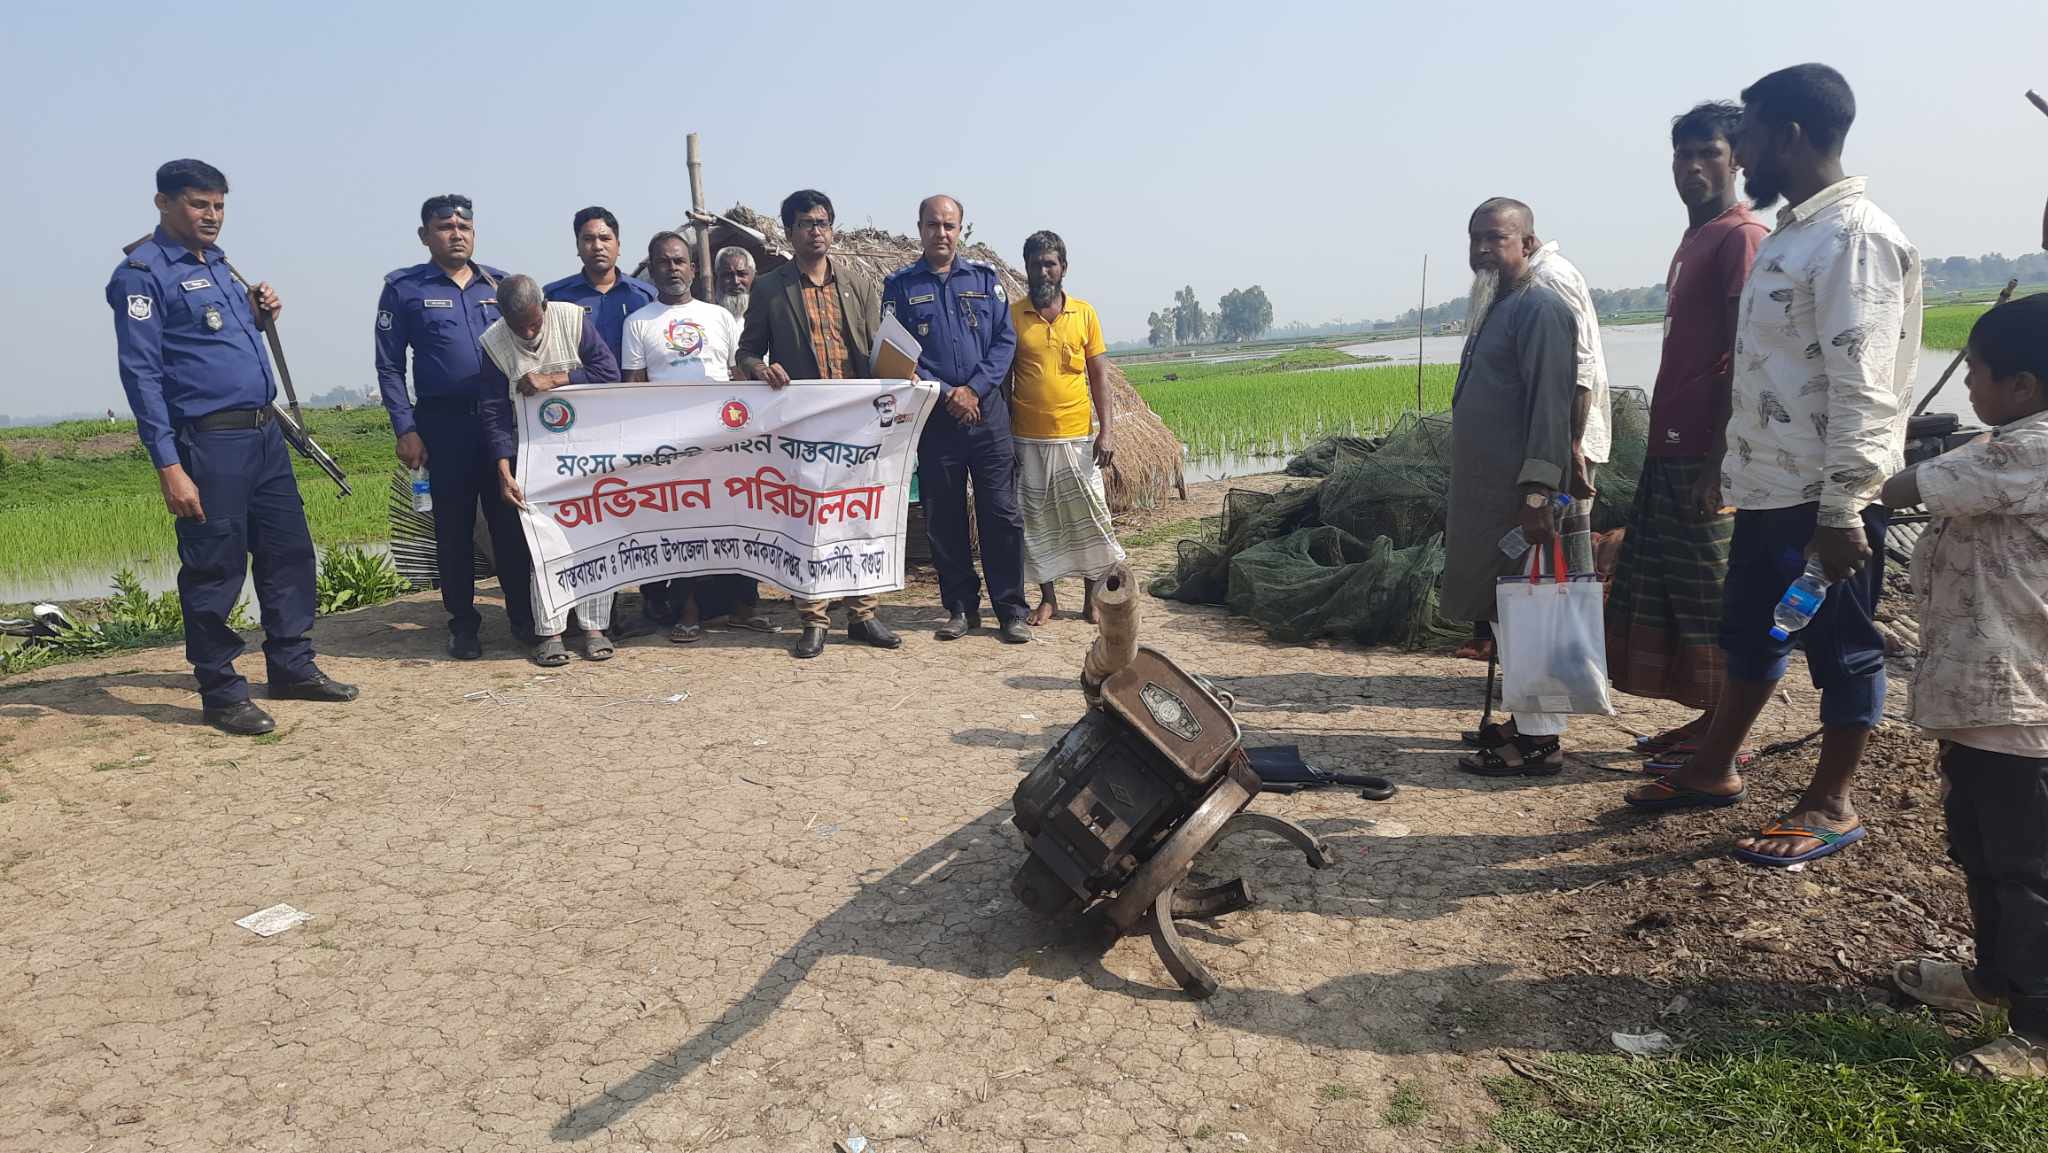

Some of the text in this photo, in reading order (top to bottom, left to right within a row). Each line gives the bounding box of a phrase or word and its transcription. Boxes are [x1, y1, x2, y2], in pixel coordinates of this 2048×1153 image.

[556, 454, 617, 477] মৎস্য
[777, 435, 882, 468] বাস্তবায়নে
[548, 466, 886, 528] অভিযান পরিচালনা
[618, 538, 659, 573] সিনিয়র
[661, 535, 709, 563] উপজেলা
[711, 538, 740, 560] মৎস্য
